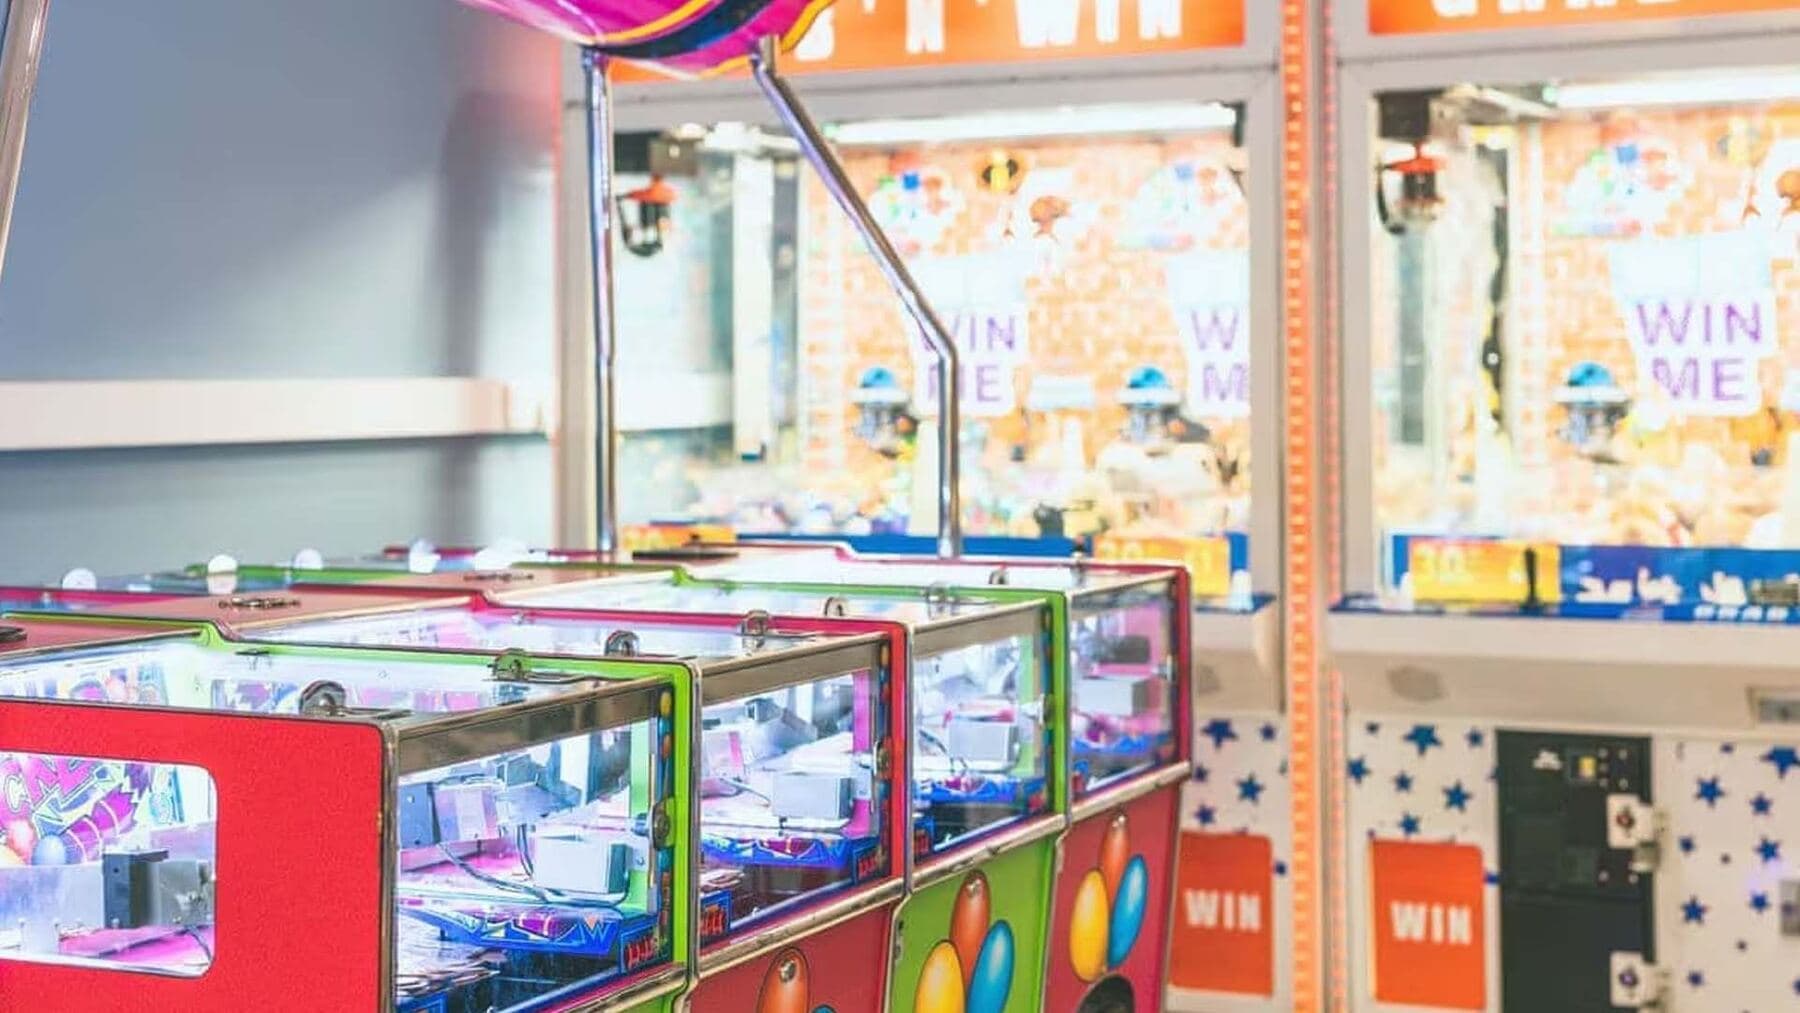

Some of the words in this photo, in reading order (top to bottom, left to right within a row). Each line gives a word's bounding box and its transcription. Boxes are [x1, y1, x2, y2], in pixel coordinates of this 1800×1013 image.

[1636, 301, 1762, 346] WIN
[1652, 357, 1746, 401] ME
[1184, 889, 1262, 932] WIN
[1390, 901, 1472, 945] WIN
